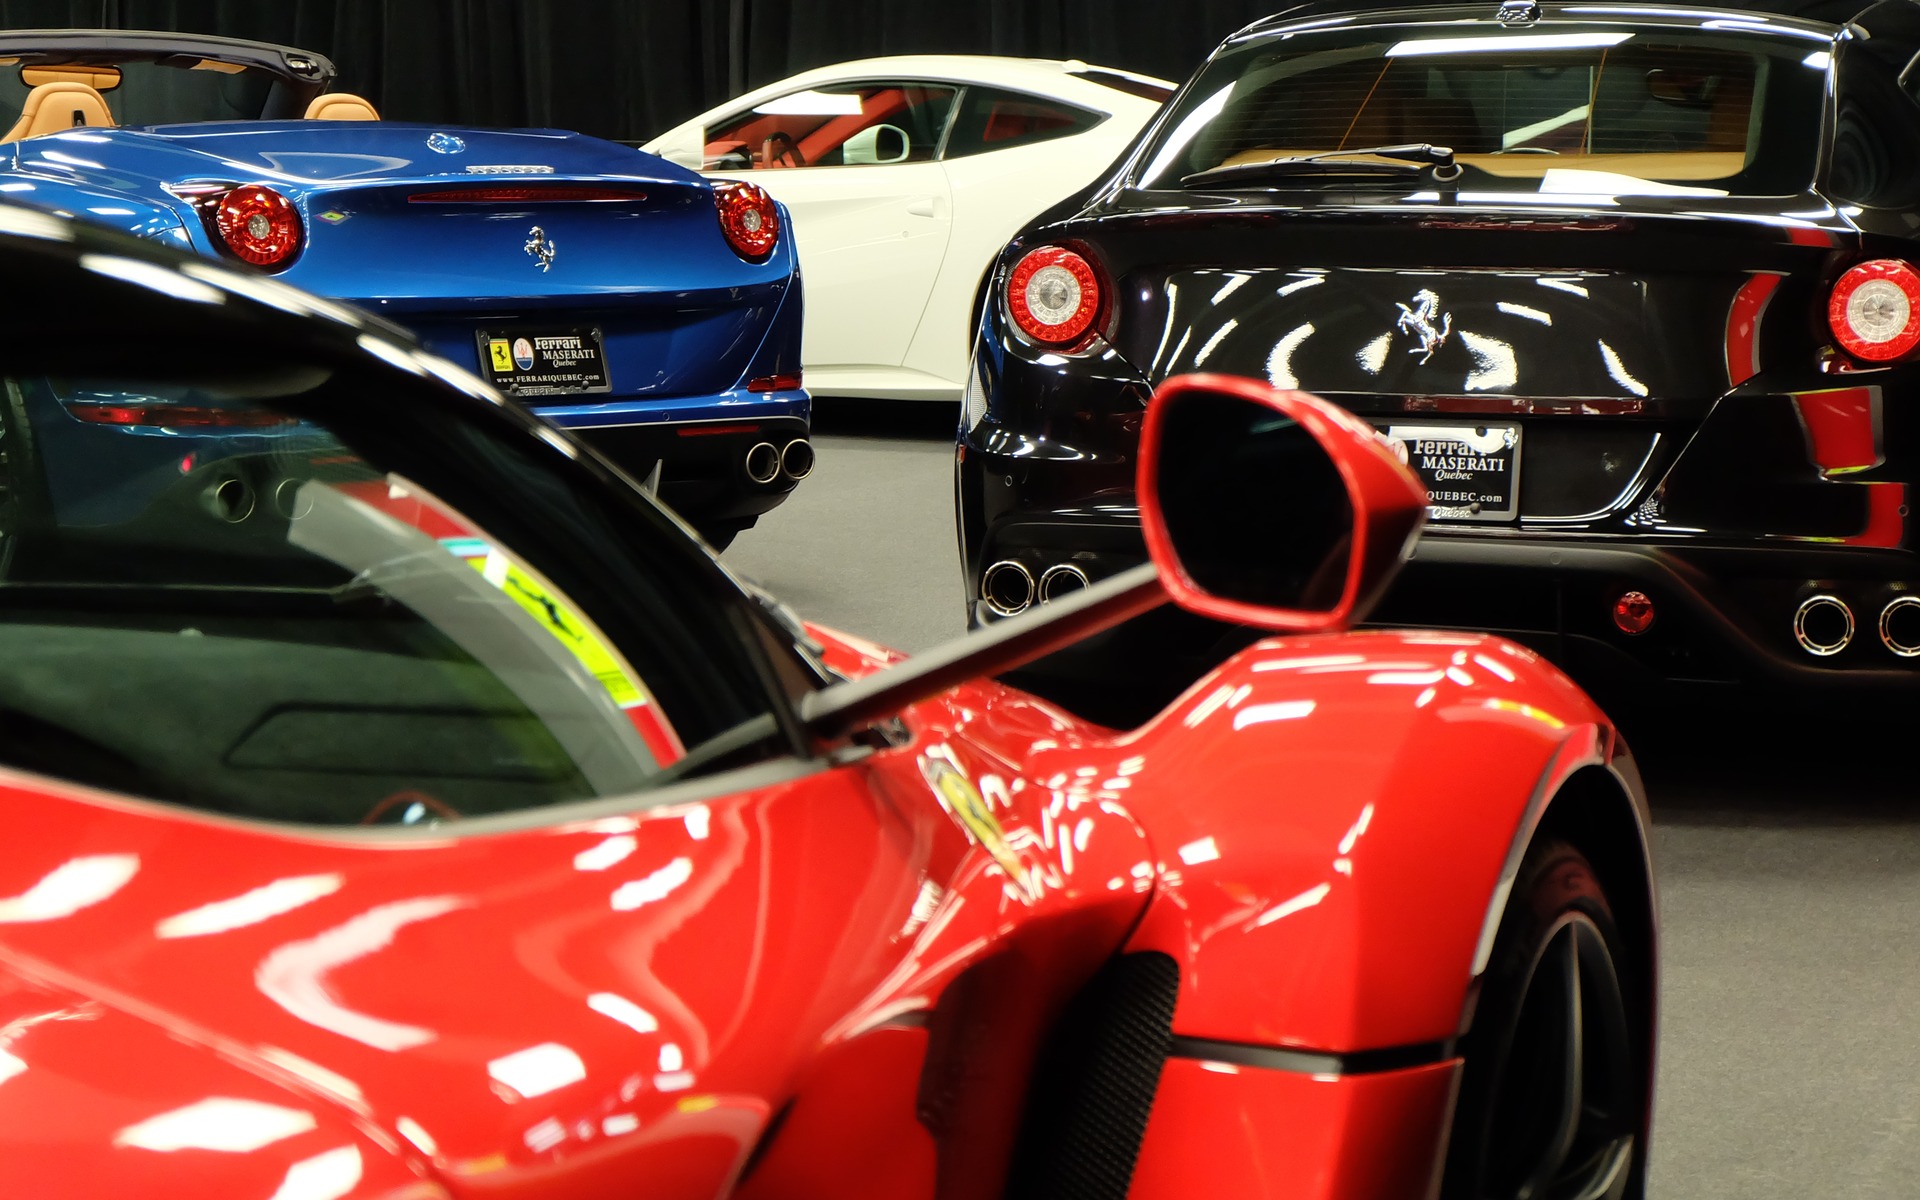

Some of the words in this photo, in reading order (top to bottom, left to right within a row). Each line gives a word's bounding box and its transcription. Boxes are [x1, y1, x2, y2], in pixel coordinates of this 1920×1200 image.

[534, 336, 581, 350] Ferrari
[542, 349, 595, 360] MASERATI
[552, 359, 577, 368] Quebec
[496, 373, 600, 383] www.FERRARIQUEBEC.com
[1421, 456, 1505, 471] MASERATI
[1434, 469, 1474, 481] Quebec
